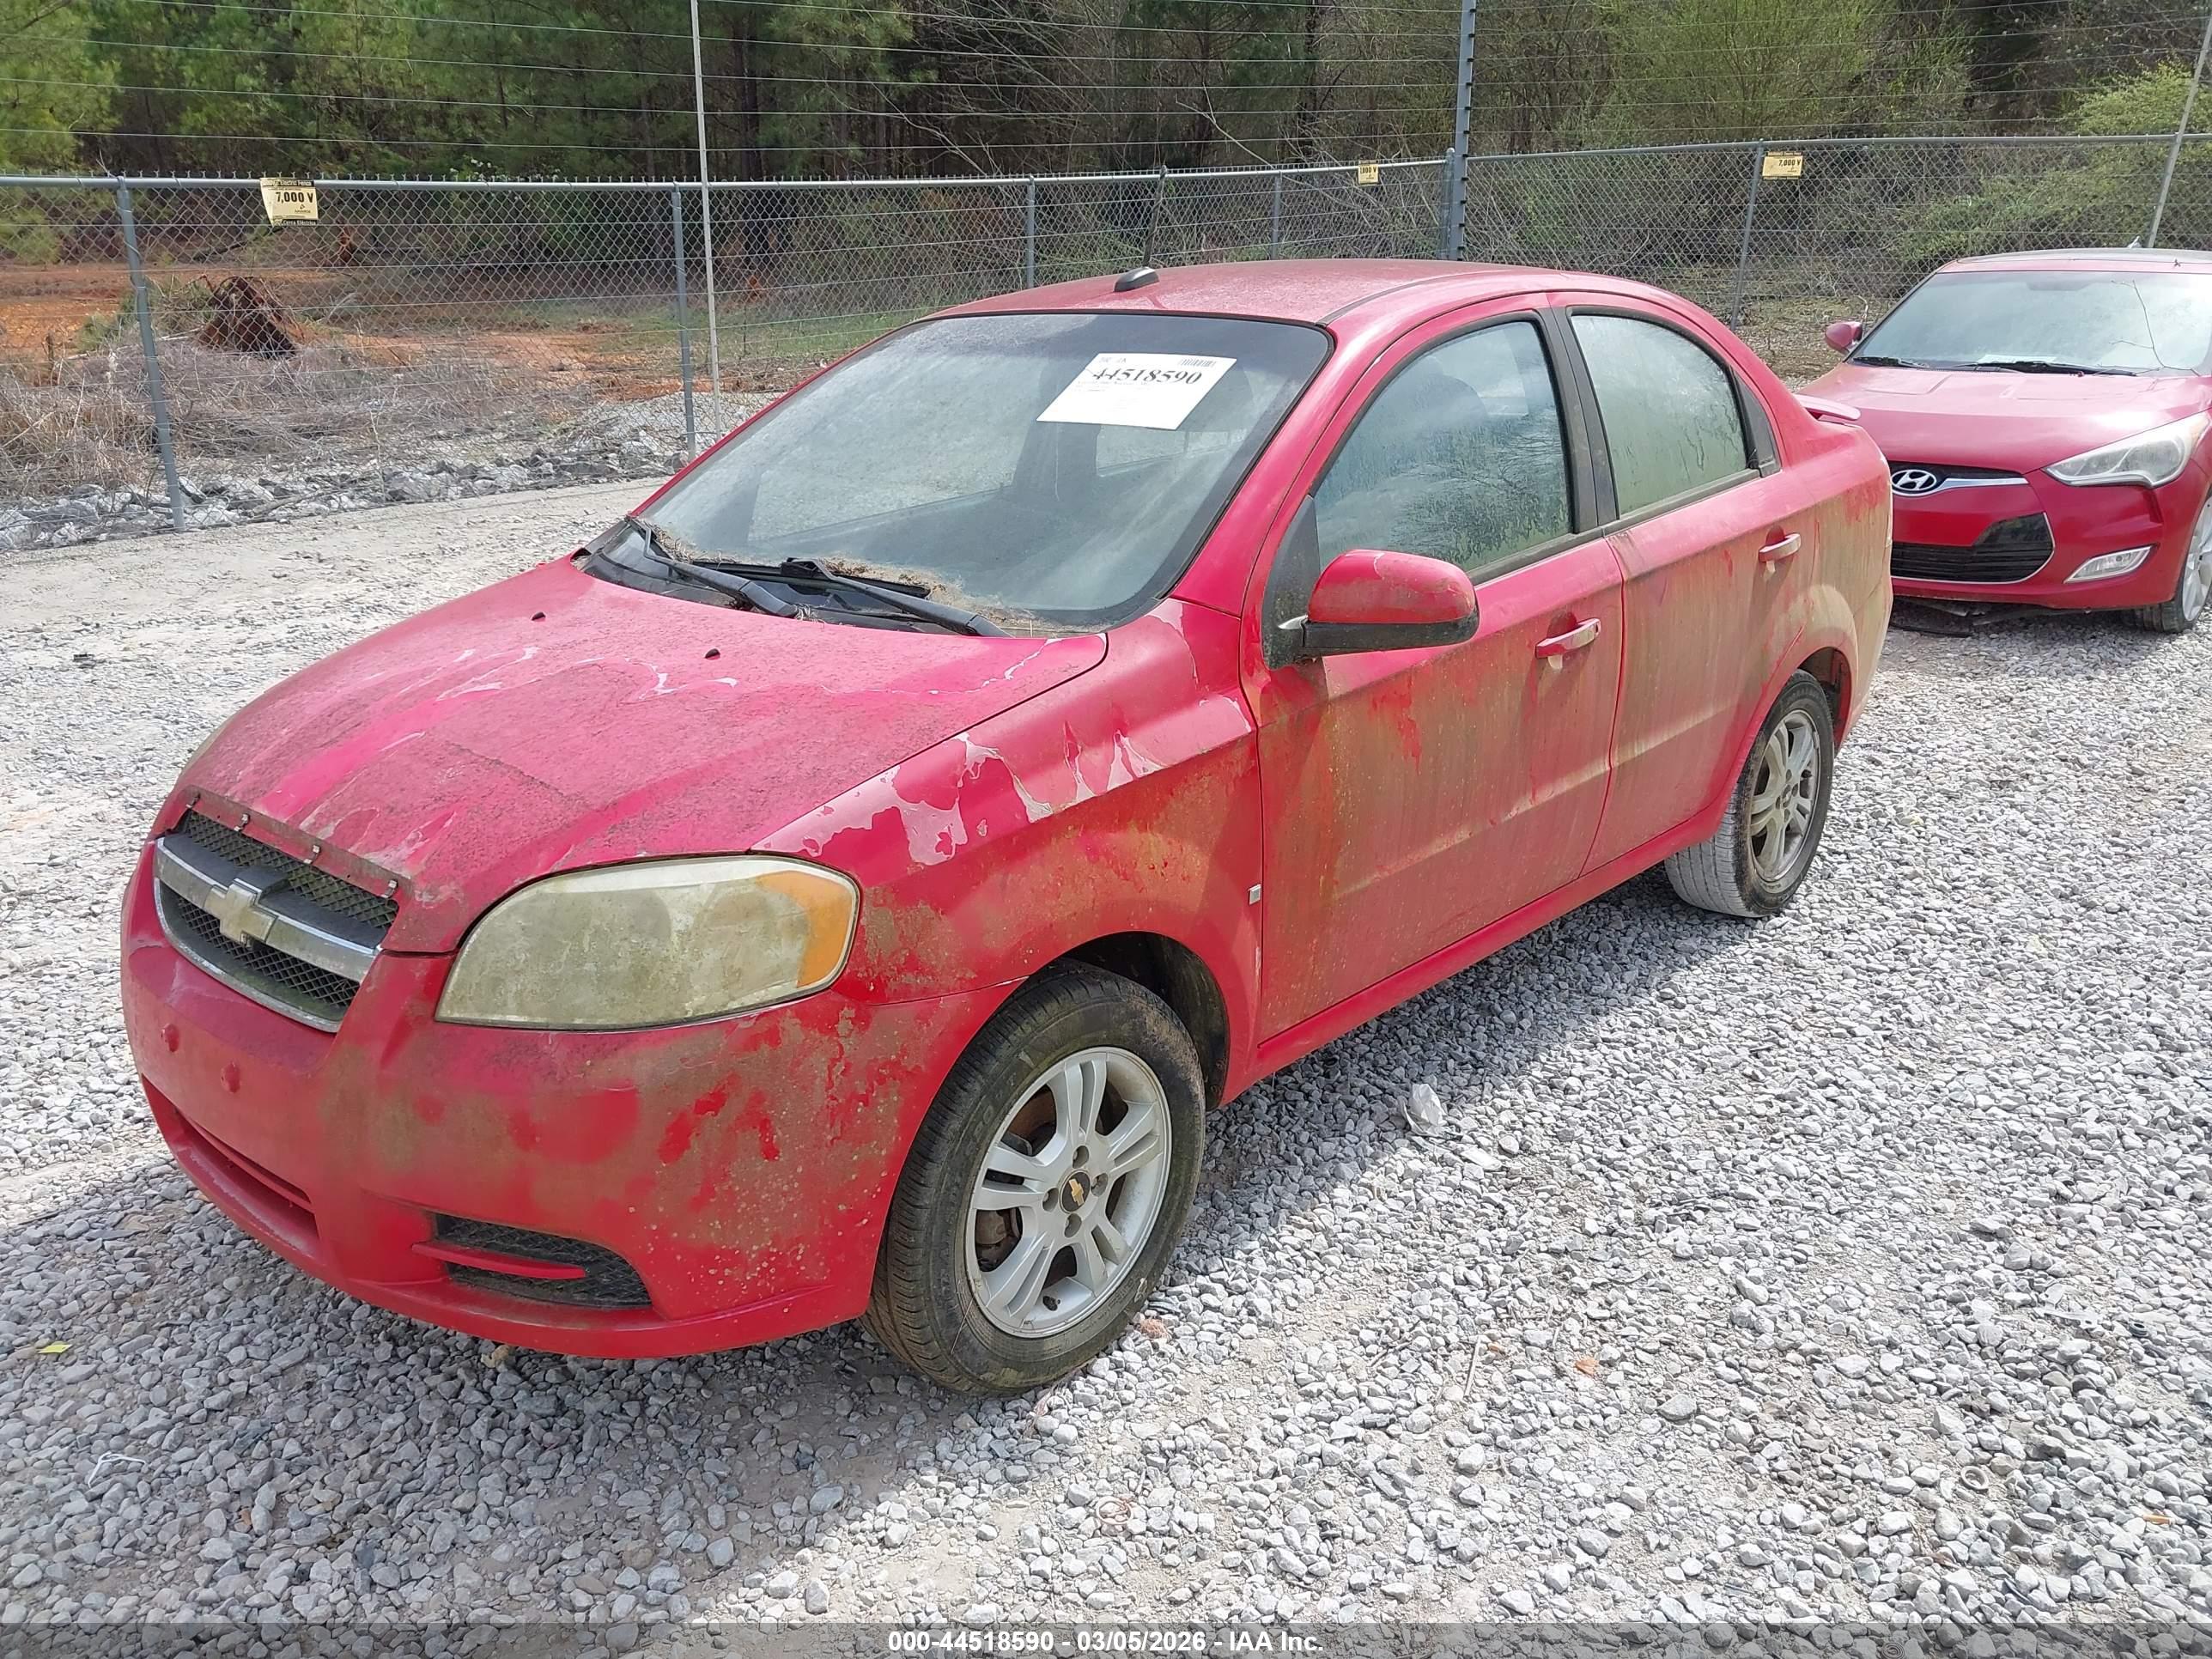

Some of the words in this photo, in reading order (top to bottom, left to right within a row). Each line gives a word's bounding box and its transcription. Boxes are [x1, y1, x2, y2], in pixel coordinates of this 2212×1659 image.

[276, 191, 305, 204] 7,000
[307, 191, 313, 204] V
[1093, 368, 1202, 385] 44518590
